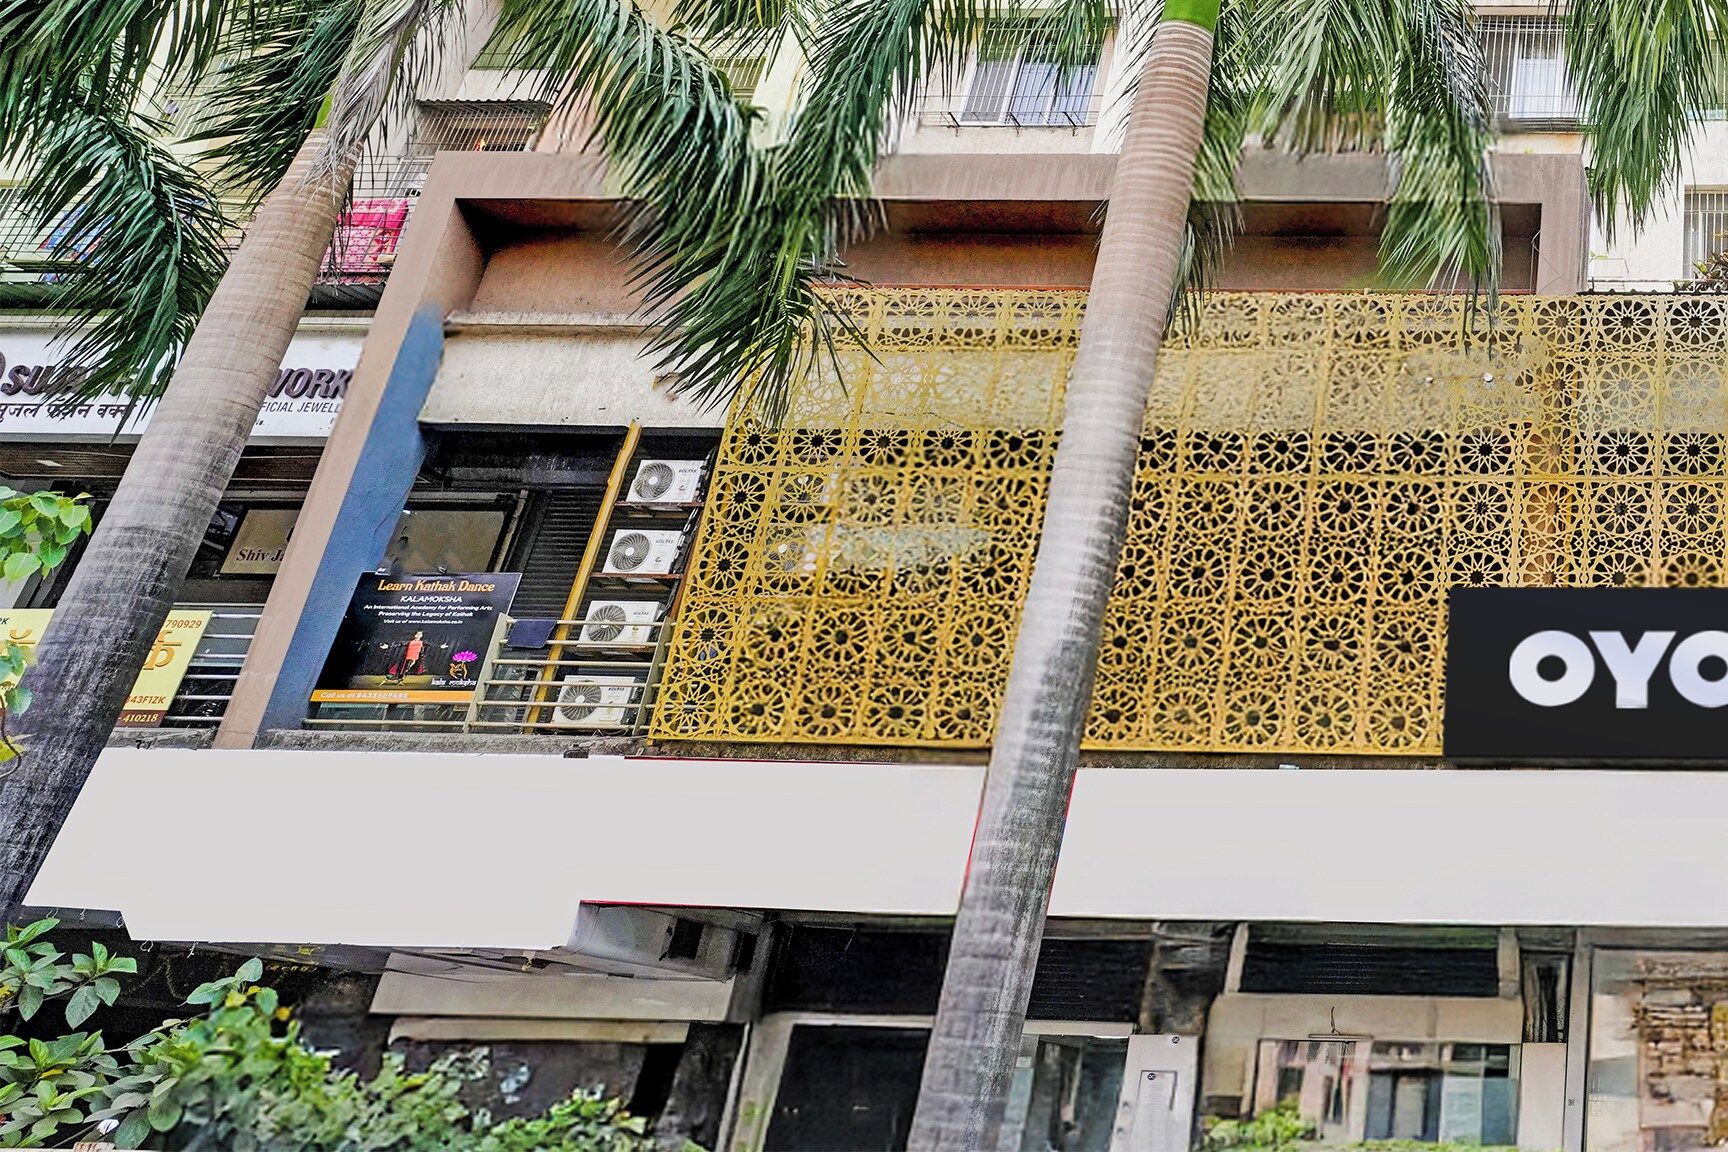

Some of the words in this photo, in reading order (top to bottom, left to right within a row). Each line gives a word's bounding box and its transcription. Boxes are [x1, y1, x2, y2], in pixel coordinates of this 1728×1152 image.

[236, 549, 269, 562] Shiv
[377, 579, 413, 591] Learn
[414, 580, 457, 592] Kathak
[457, 580, 496, 592] Dance
[400, 595, 463, 603] KALAMOKSHA
[123, 714, 159, 723] 410218
